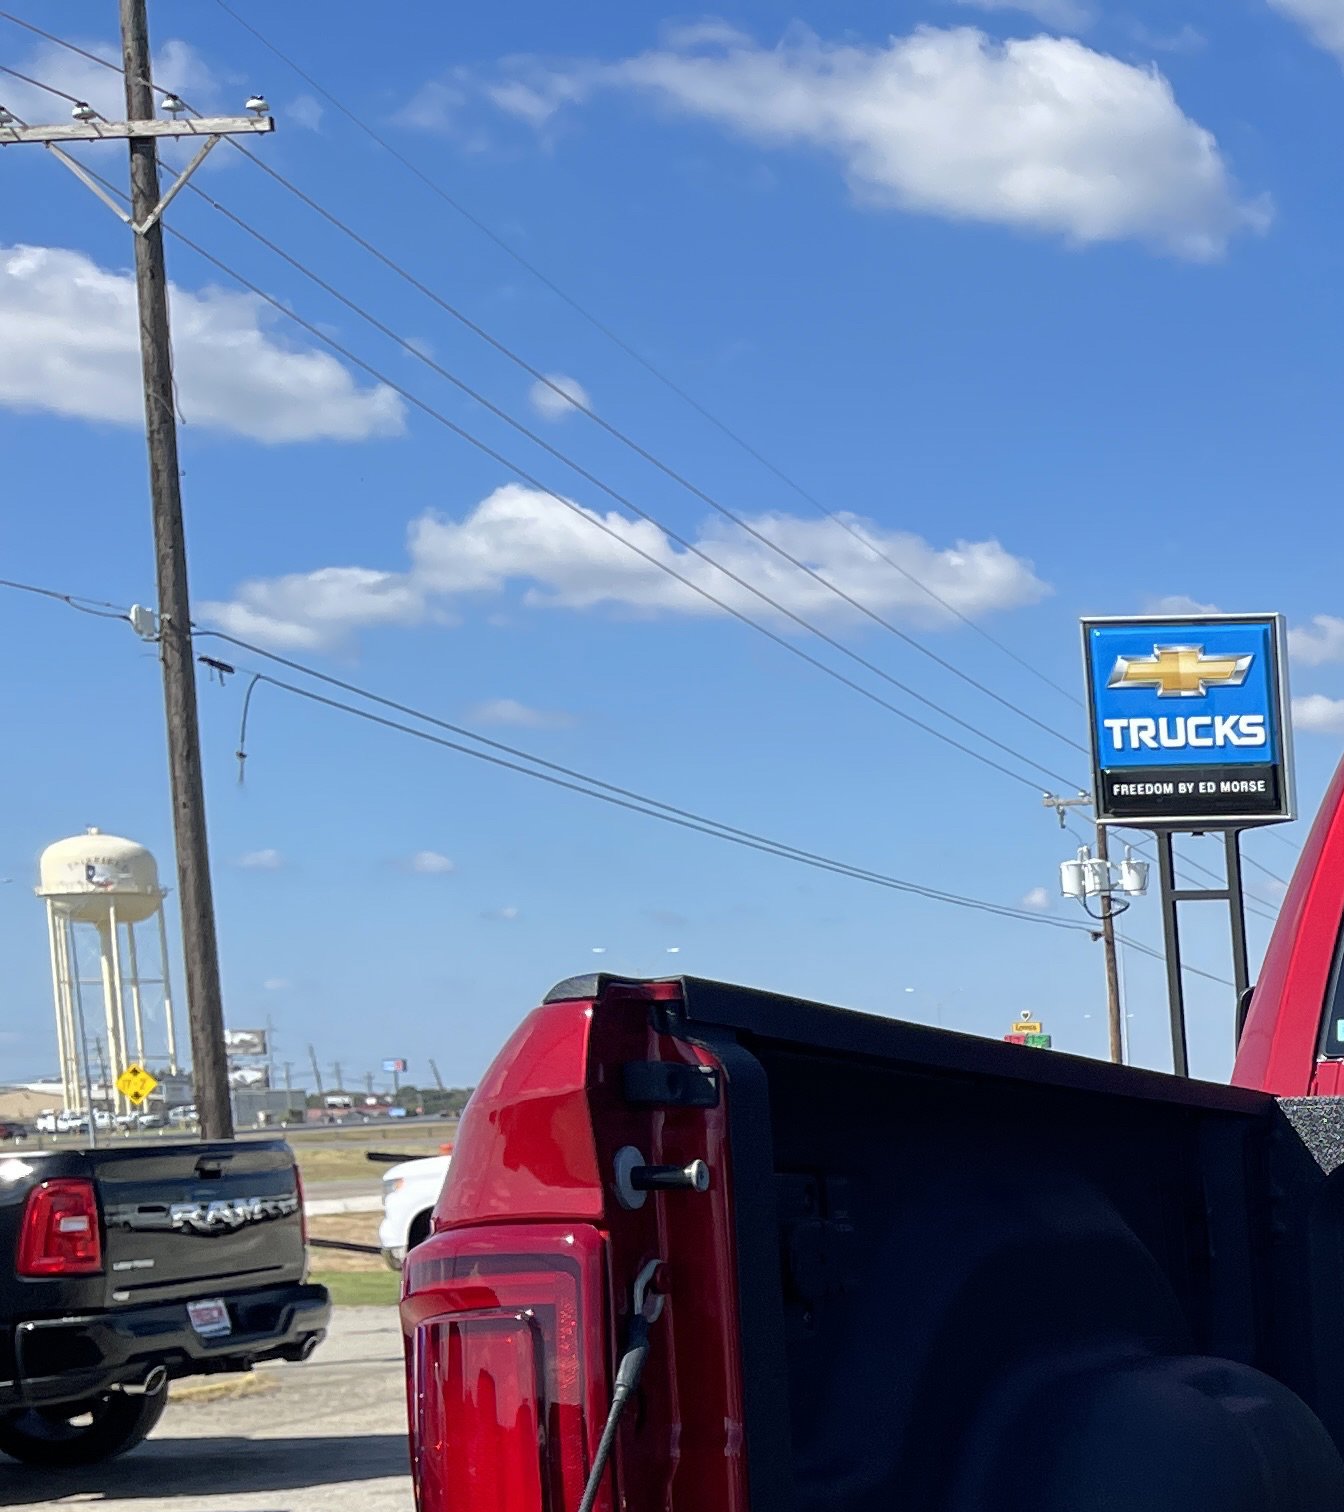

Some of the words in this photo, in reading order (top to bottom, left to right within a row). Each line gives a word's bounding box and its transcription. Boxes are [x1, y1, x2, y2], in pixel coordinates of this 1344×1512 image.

[1104, 714, 1266, 750] TRUCKS
[1113, 782, 1174, 796] FREEDOM
[1178, 781, 1195, 794] BY
[1199, 780, 1217, 794] ED
[1220, 779, 1267, 793] MORSE
